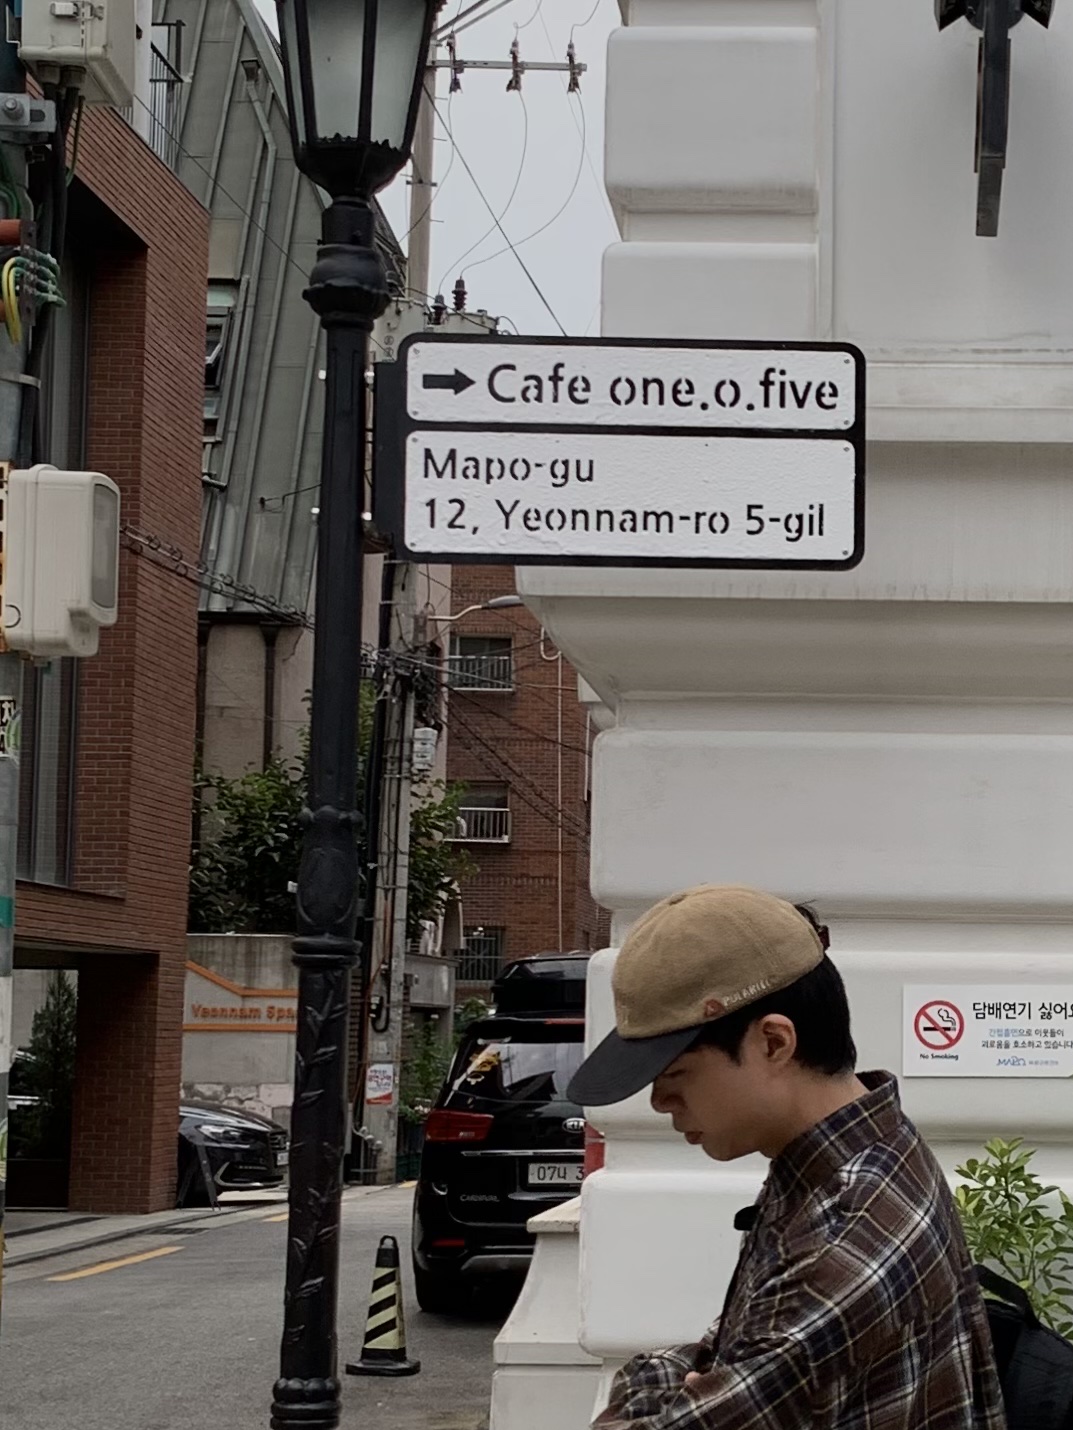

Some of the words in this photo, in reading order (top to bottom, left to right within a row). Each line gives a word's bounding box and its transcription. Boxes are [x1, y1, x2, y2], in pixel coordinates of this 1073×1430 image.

[487, 362, 592, 405] Cafe
[608, 367, 839, 412] one.o.five
[422, 447, 595, 488] Mapo-gu
[425, 498, 479, 536] 12,
[495, 499, 730, 535] Yeonnam-ro
[745, 503, 825, 542] 5-gil
[191, 1004, 262, 1019] Yeonnam
[972, 1001, 1031, 1020] 담배연기
[1044, 1040, 1073, 1049] 있습니다
